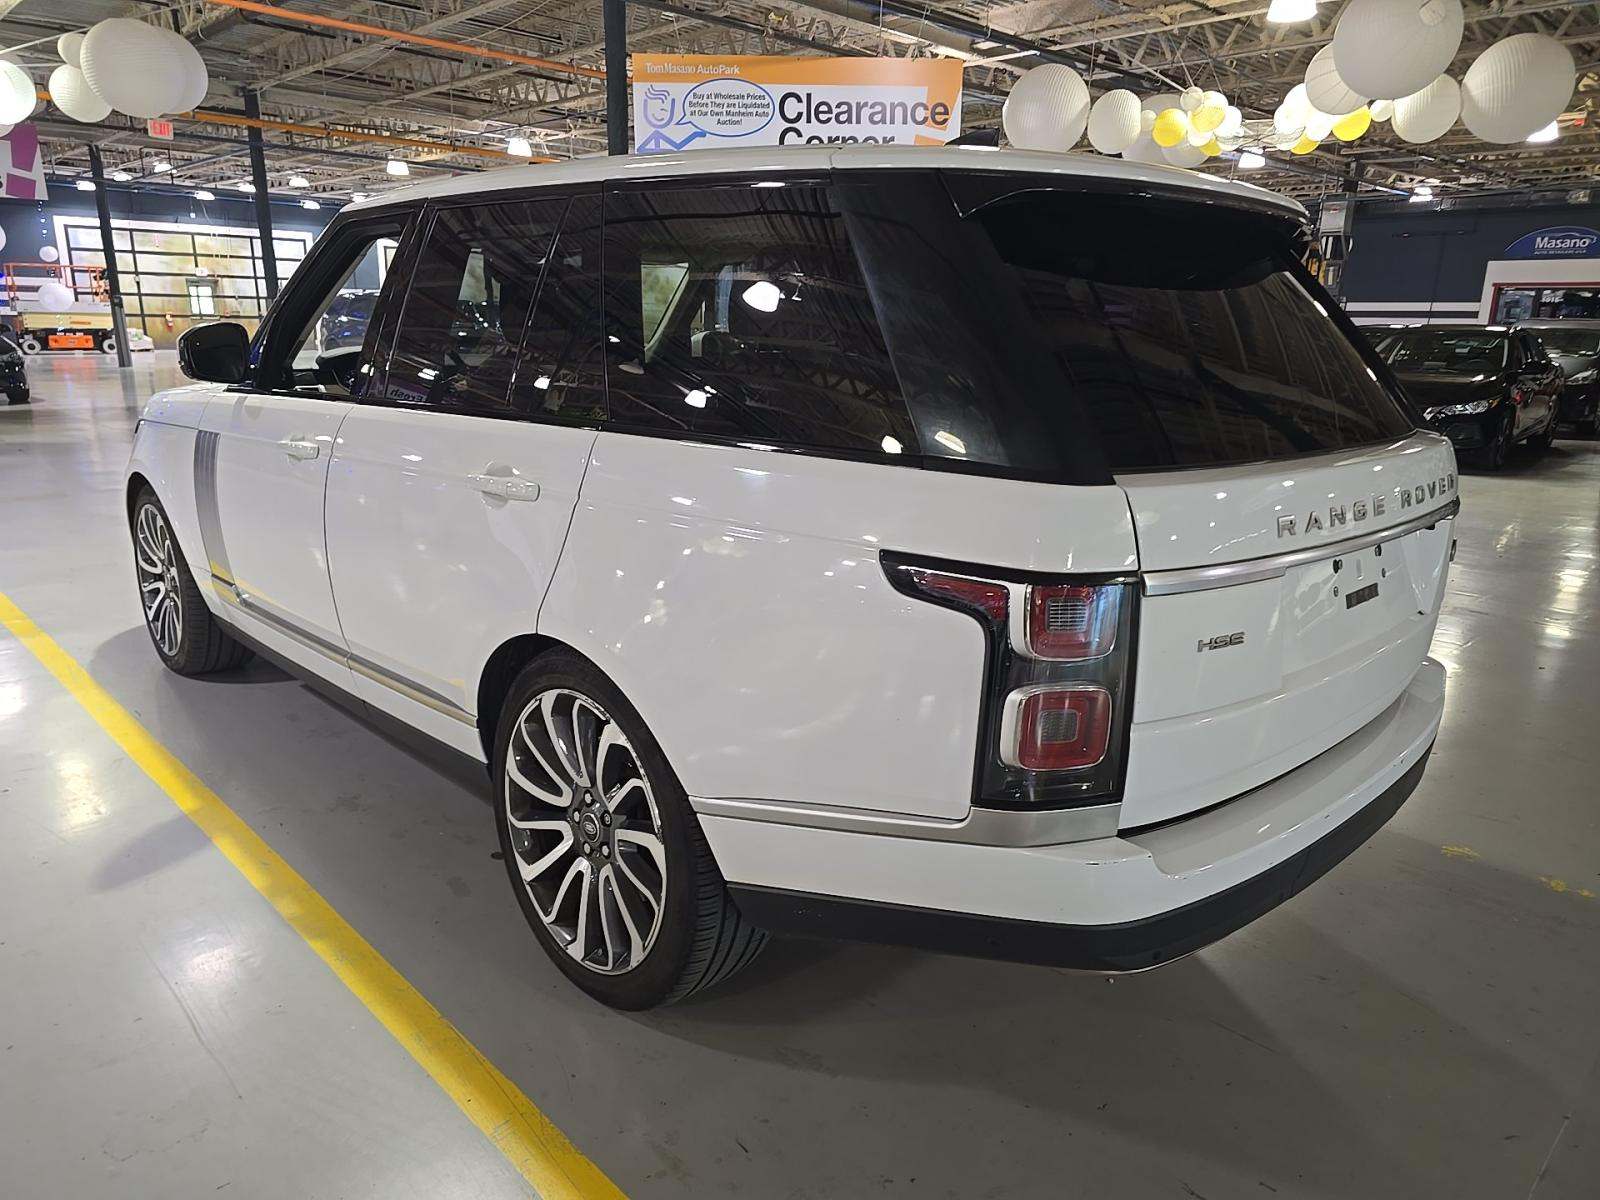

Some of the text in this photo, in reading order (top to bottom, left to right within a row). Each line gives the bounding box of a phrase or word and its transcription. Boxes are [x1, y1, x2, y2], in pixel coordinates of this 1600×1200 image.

[697, 64, 740, 75] AutoPark
[692, 92, 705, 101] Buy
[714, 92, 746, 100] Wholesale
[710, 101, 725, 109] They
[737, 101, 770, 110] Liquidated
[778, 91, 950, 126] Clearance
[152, 121, 171, 137] EXIT
[1534, 236, 1590, 249] Masano
[1277, 472, 1455, 539] RANGE ROVER
[1197, 631, 1246, 653] HSE
